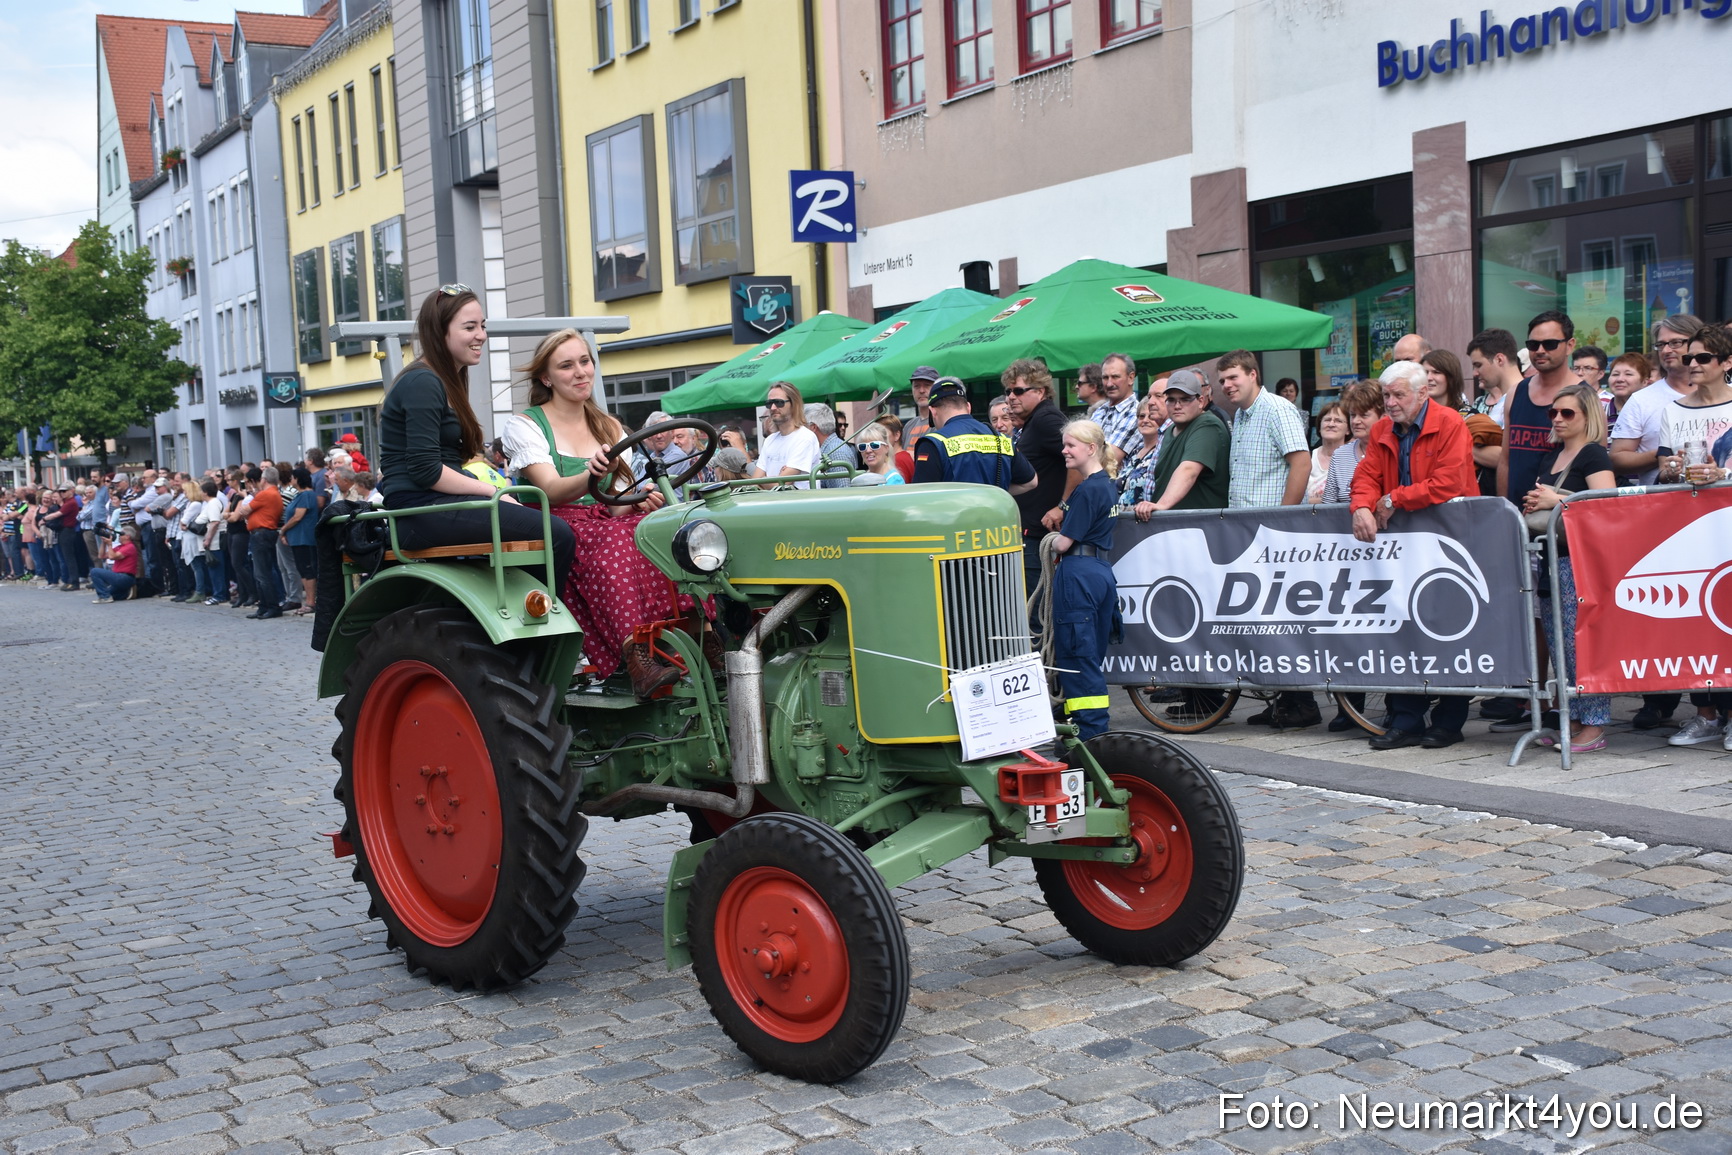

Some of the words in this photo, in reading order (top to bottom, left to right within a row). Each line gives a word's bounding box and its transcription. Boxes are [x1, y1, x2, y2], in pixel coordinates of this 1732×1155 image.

[863, 260, 885, 275] Unterer
[886, 256, 905, 271] Markt
[905, 253, 913, 267] 15
[757, 294, 778, 322] G2
[1118, 305, 1208, 318] Neumarkter
[1112, 311, 1239, 328] Lammsbräu
[1374, 319, 1406, 331] GARTEN
[1379, 330, 1402, 340] BUCH
[1672, 417, 1729, 434] ALWAYS
[954, 524, 1018, 552] FENDT
[774, 542, 843, 560] Dieselross
[1253, 540, 1402, 564] Autoklassik
[1215, 568, 1393, 616] Dietz
[1210, 624, 1305, 636] BREITENBRUNN
[1100, 648, 1495, 675] www.autoklassik-dietz.de
[1619, 654, 1732, 679] www.
[1002, 673, 1030, 696] 622
[1062, 795, 1080, 816] 53
